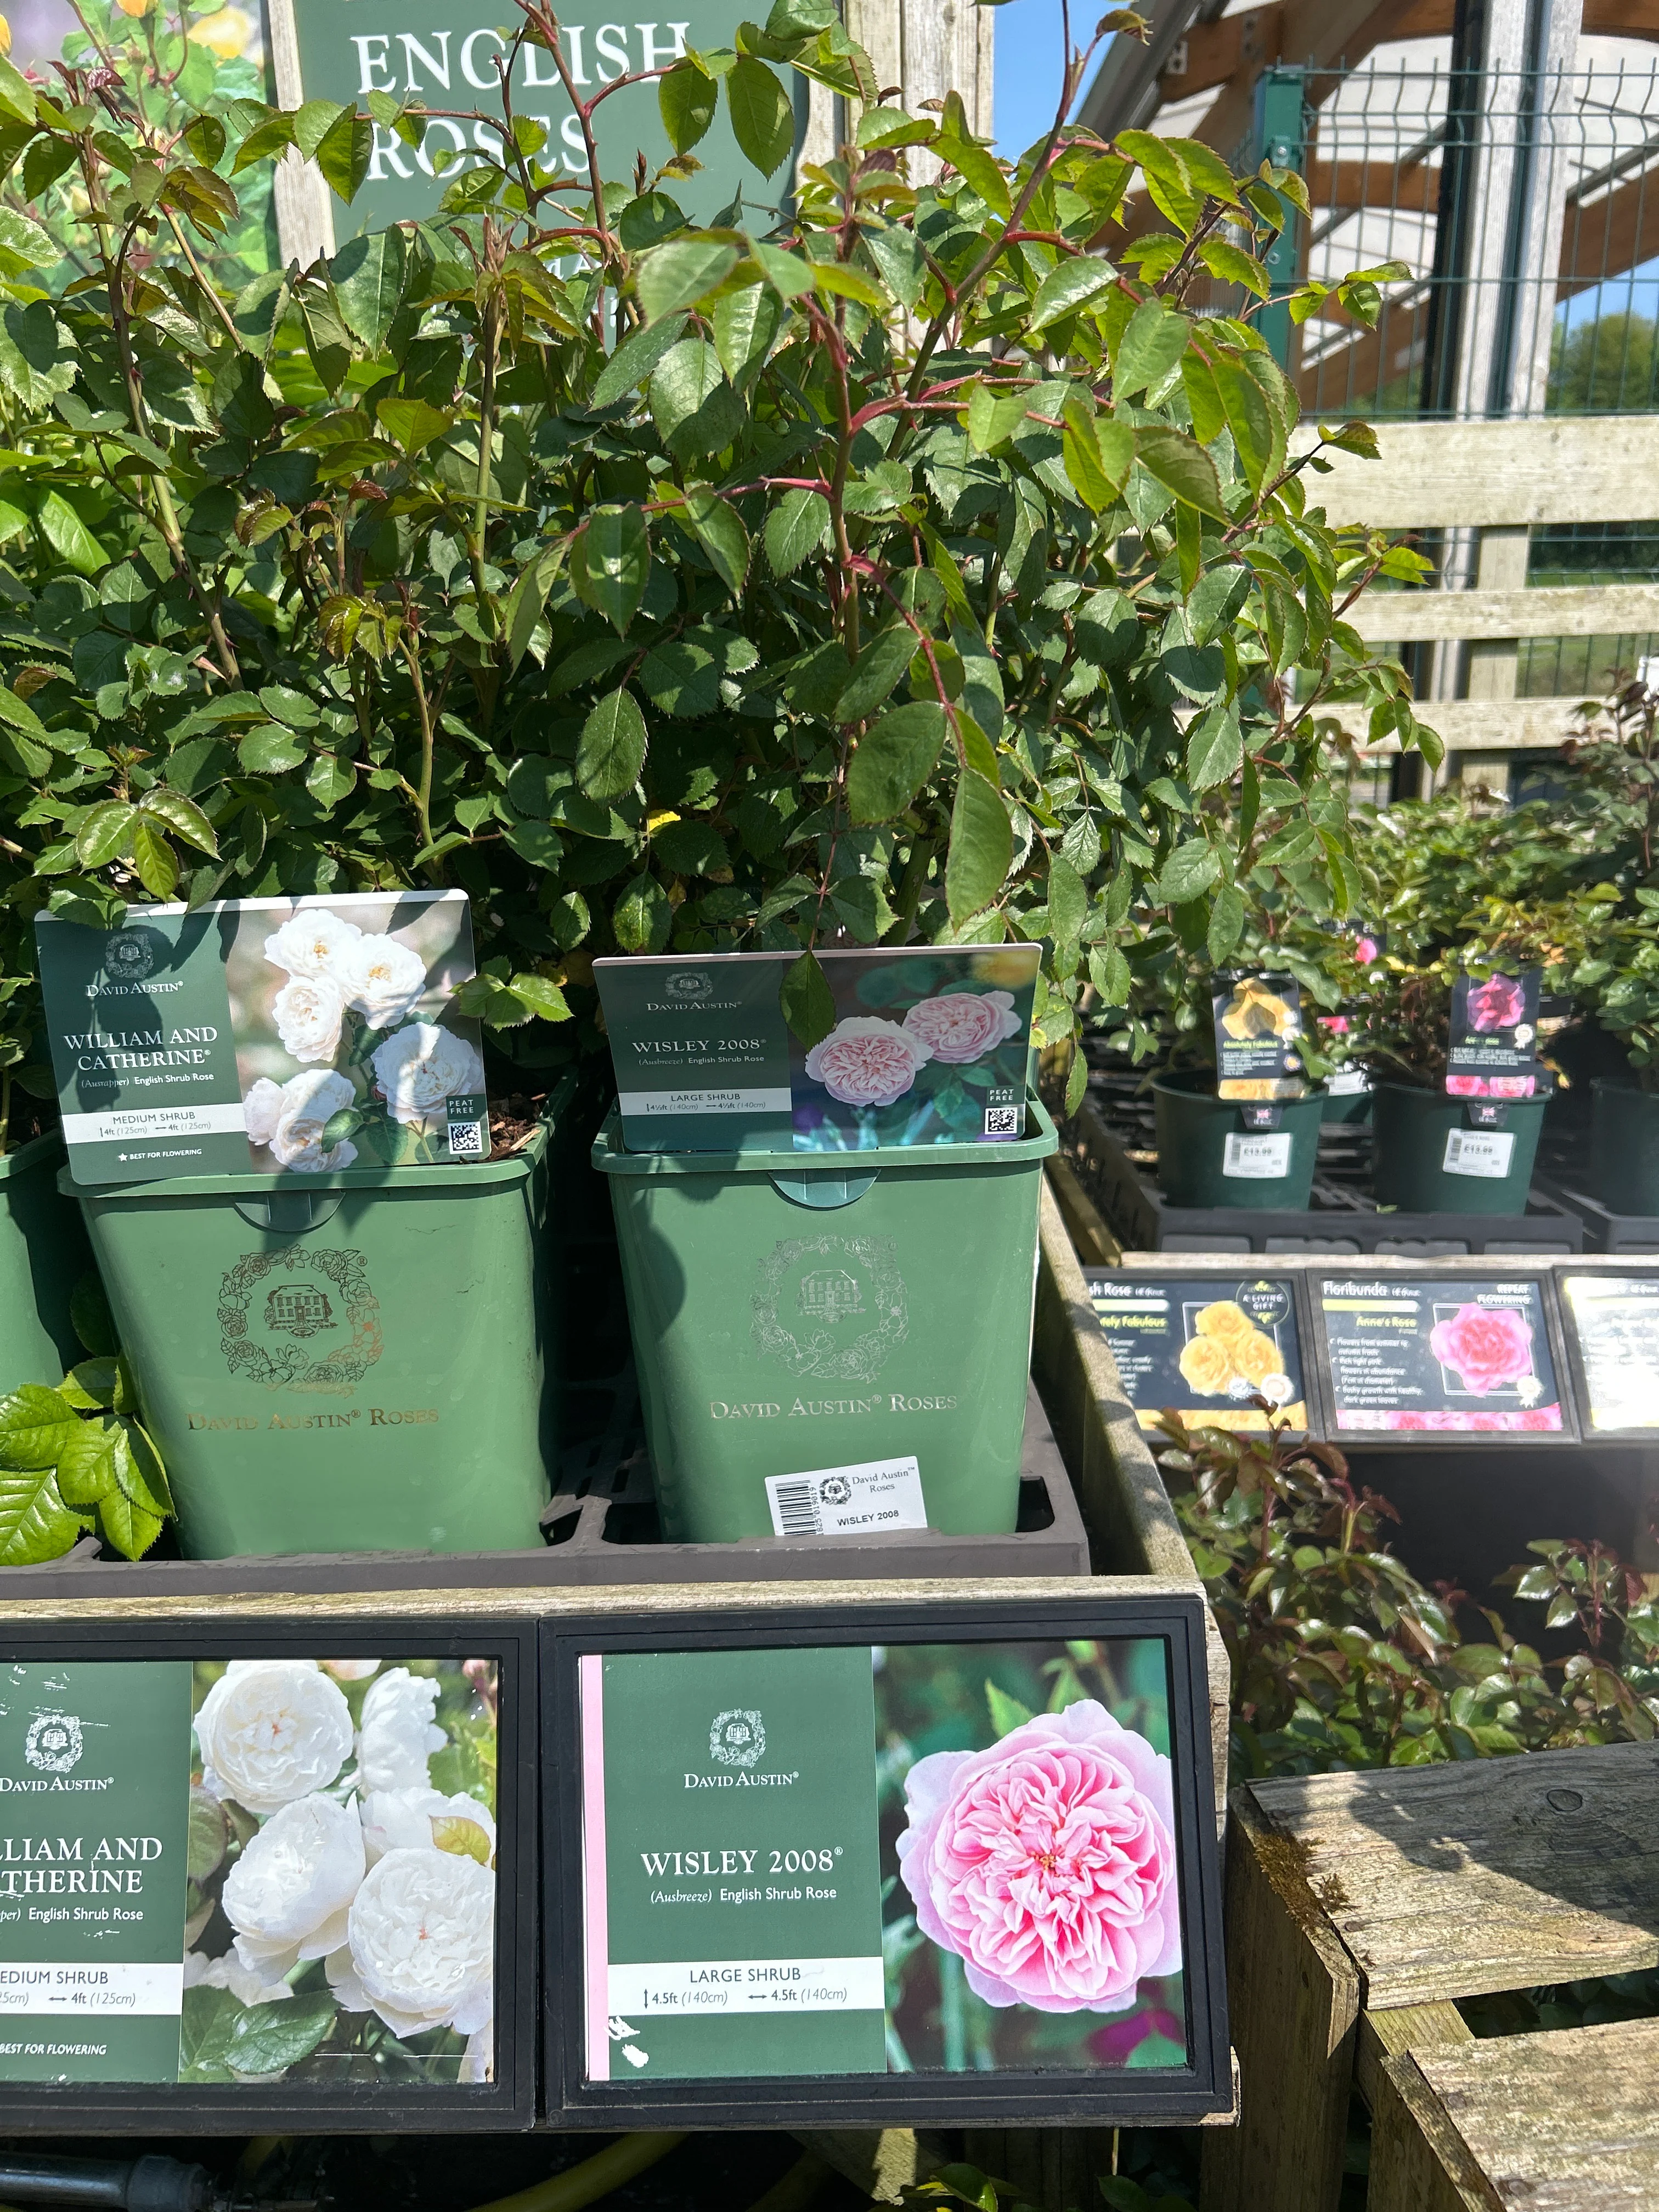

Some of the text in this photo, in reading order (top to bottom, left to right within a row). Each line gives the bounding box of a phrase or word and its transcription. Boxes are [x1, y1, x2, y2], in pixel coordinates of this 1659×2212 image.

[350, 21, 691, 95] ENGLISH
[86, 985, 128, 997] DAVID
[646, 1003, 688, 1012] DAVID
[63, 1026, 218, 1050] WILLIAM AND
[632, 1040, 710, 1053] WISLEY
[134, 1076, 163, 1086] English
[165, 1074, 191, 1083] Shrub
[193, 1073, 215, 1081] Rose
[113, 1111, 195, 1125] MEDIUM SHRUB
[117, 1126, 148, 1136] (125cm)
[181, 1121, 211, 1131] (125cm)
[162, 1149, 202, 1158] FLOWERING
[1323, 1280, 1388, 1296] Floribunda
[710, 1401, 781, 1420] DAVID
[889, 1394, 958, 1412] ROSES
[185, 1413, 258, 1431] DAVID
[368, 1408, 439, 1426] ROSES
[852, 1473, 878, 1485] David
[870, 1483, 895, 1493] Roses
[837, 1509, 899, 1527] WISLEY 2008
[0, 1778, 48, 1792] DAVID
[684, 1773, 734, 1789] DAVID
[0, 1837, 162, 1861] LIAM AND
[641, 1850, 758, 1876] WISLEY
[651, 1886, 837, 1904] (Ausbreeze) English Shrub Rose
[29, 1907, 70, 1923] English
[74, 1908, 109, 1920] Shrub
[113, 1908, 143, 1920] Rose
[57, 1971, 109, 1984] SHRUB
[690, 1967, 801, 1983] LARGE SHRUB
[71, 1992, 87, 2004] 4ft
[91, 1992, 136, 2007] (125cm)
[652, 1987, 847, 2006] 4.5ft (140cm) 4.5ft (140cm)
[25, 2043, 44, 2055] FOR
[47, 2044, 107, 2055] FLOWERING
